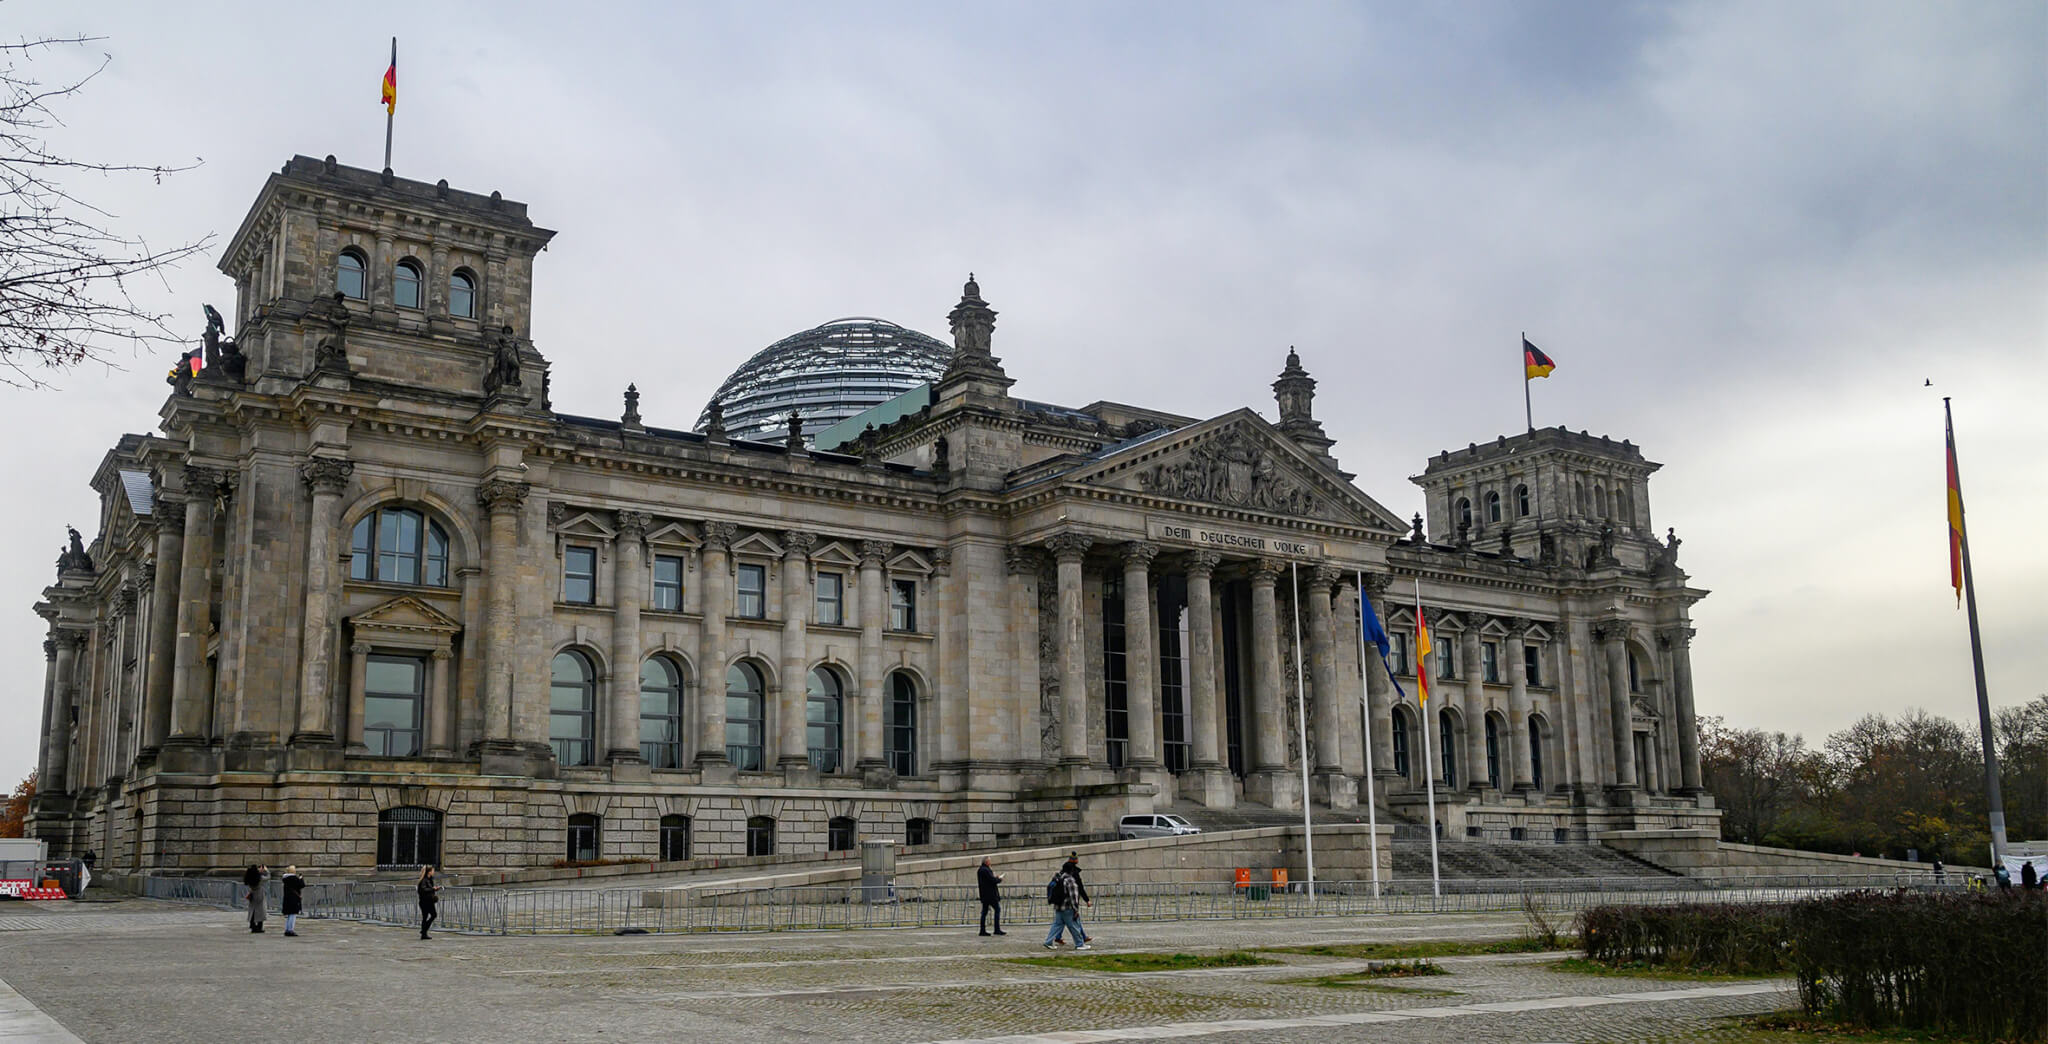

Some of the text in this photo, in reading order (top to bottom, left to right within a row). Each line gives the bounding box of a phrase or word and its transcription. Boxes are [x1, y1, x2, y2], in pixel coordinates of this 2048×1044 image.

[1165, 526, 1306, 555] DEM DEUTSCHEN VOLKE
